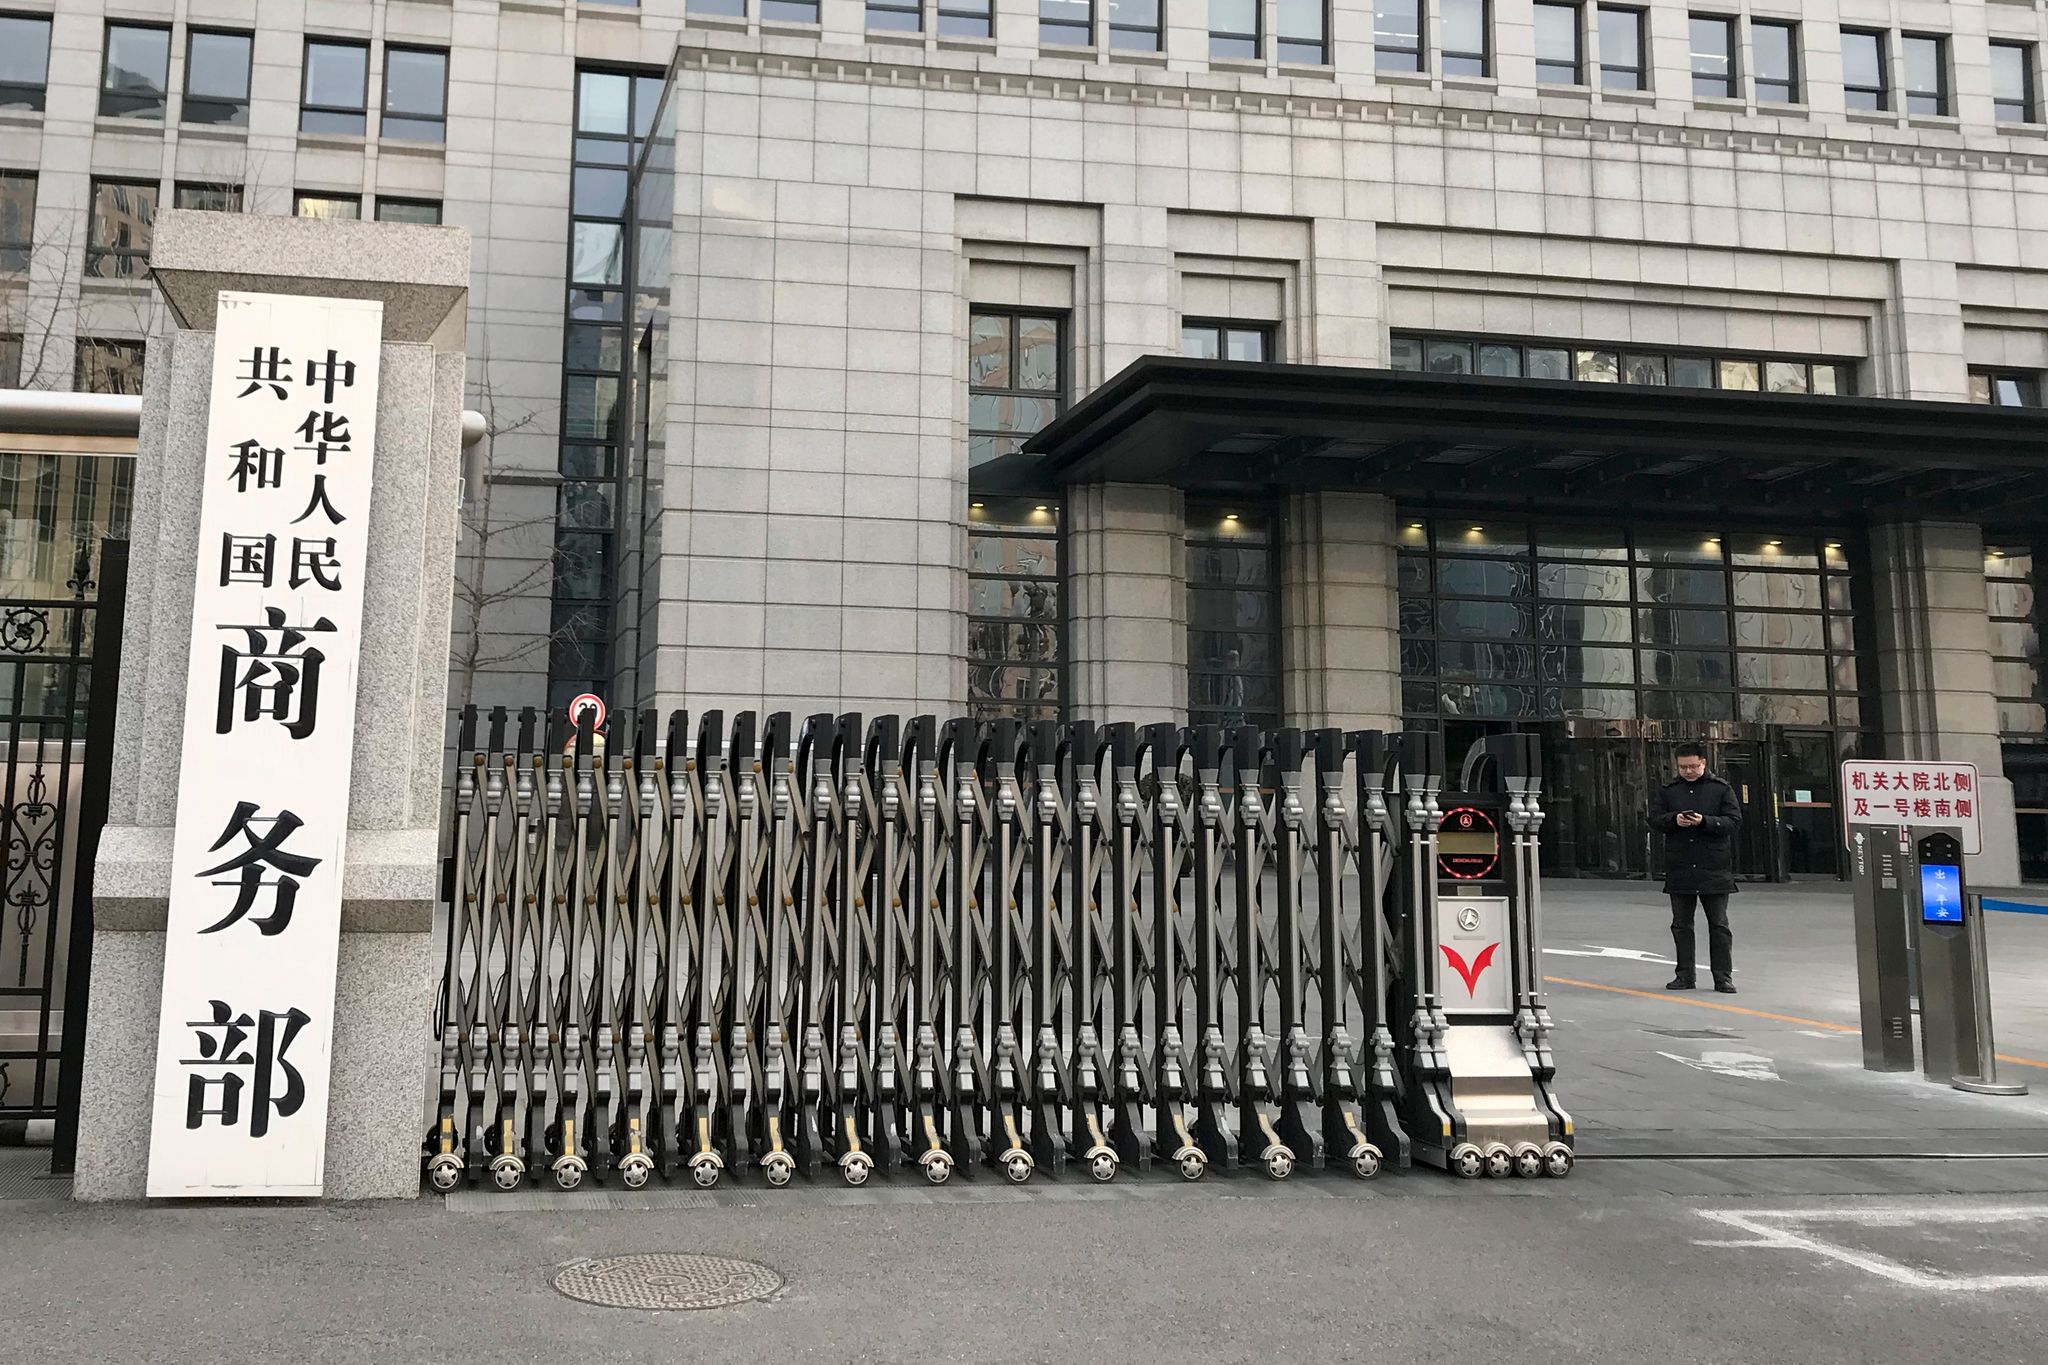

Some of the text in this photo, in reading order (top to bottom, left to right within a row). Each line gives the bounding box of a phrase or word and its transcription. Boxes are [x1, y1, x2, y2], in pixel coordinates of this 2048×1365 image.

[219, 346, 293, 588] 共和国
[289, 349, 357, 592] 中华人民
[1851, 771, 1972, 792] 机关大院北侧
[1853, 798, 1973, 818] 及一号楼南侧
[179, 606, 338, 1138] 商务部
[1935, 868, 1949, 918] 出入平安
